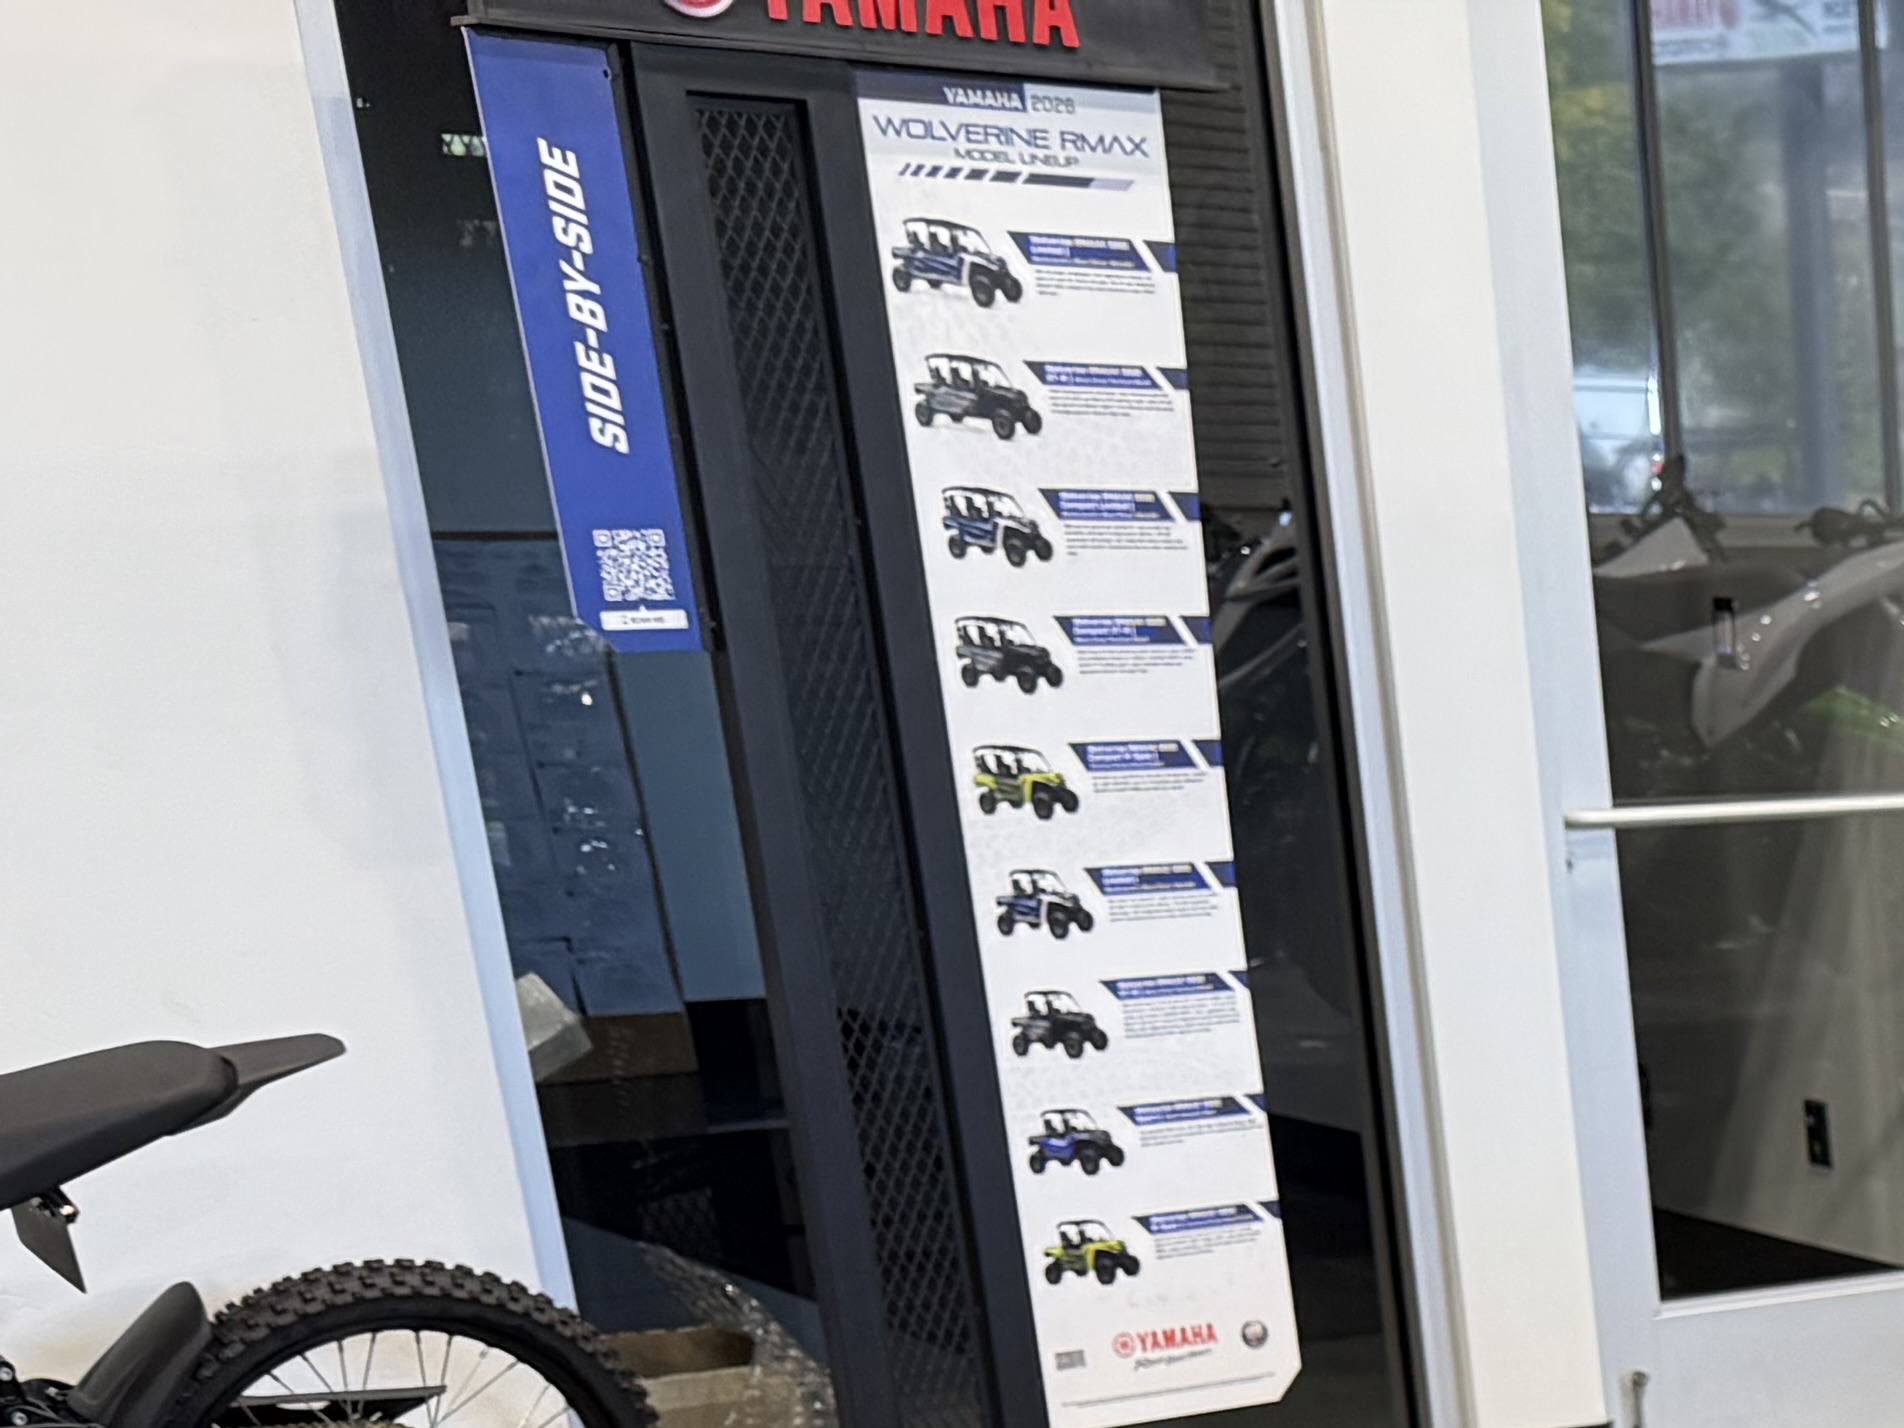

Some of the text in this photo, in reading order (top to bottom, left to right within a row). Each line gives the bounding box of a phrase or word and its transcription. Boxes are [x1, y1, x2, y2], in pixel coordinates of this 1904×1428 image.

[942, 86, 1024, 111] YAMAHA
[872, 114, 1149, 158] WOLVERINE RMAX
[536, 136, 630, 456] SIDE-BY-SIDE
[1136, 1322, 1218, 1354] YAMAHA
